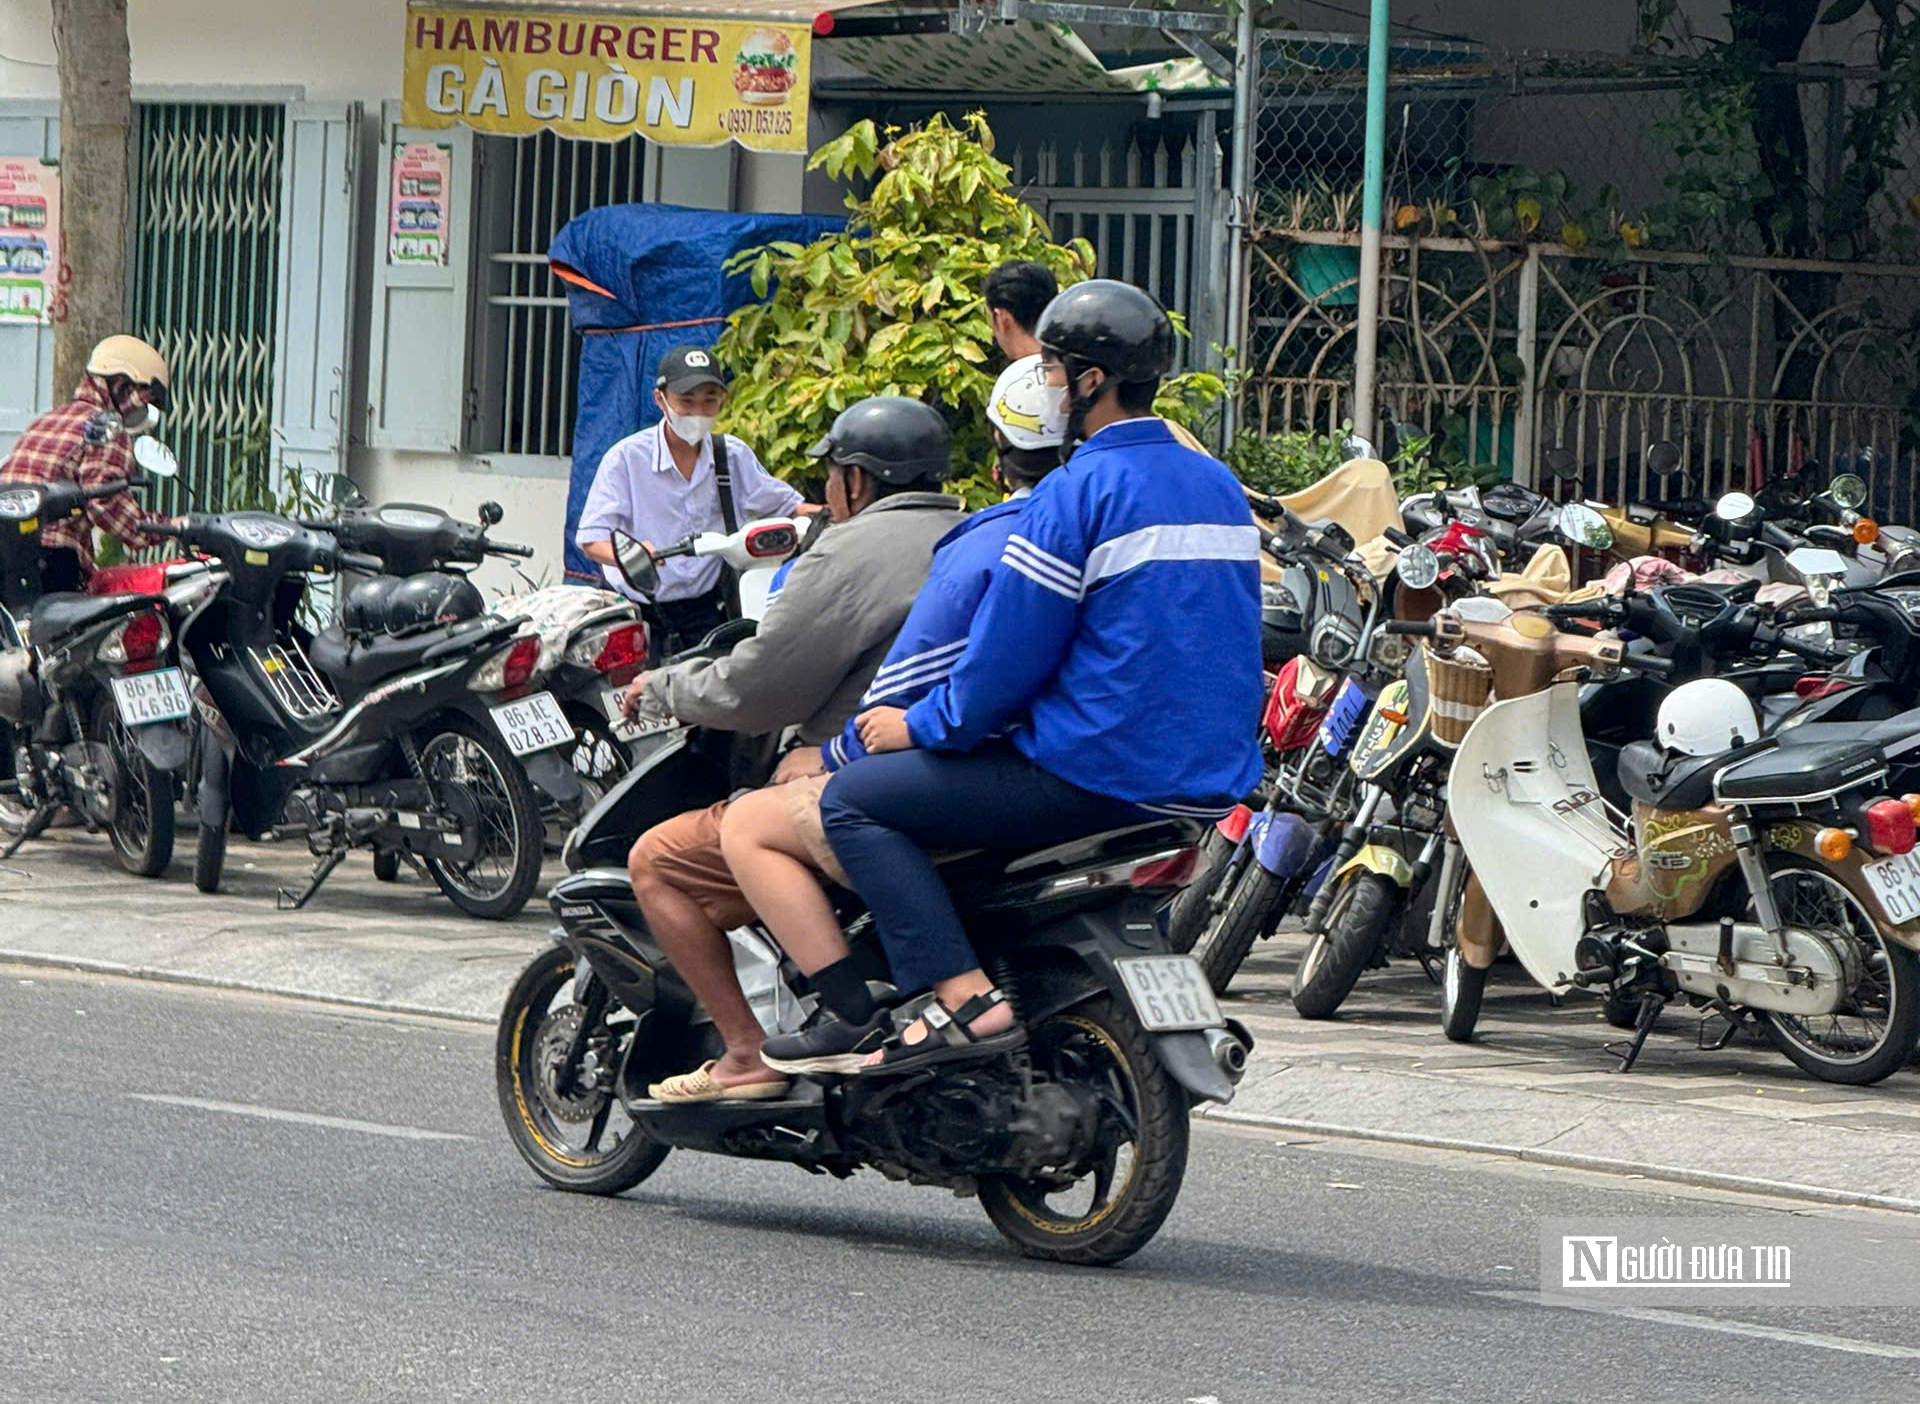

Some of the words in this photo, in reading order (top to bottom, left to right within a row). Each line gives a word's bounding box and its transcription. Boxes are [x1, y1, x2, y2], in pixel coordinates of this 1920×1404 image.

[416, 16, 721, 65] HAMBURGER
[425, 56, 509, 118] GÀ
[524, 62, 696, 129] GIÒN
[503, 697, 552, 729] 86-AE
[509, 718, 569, 752] 028.31
